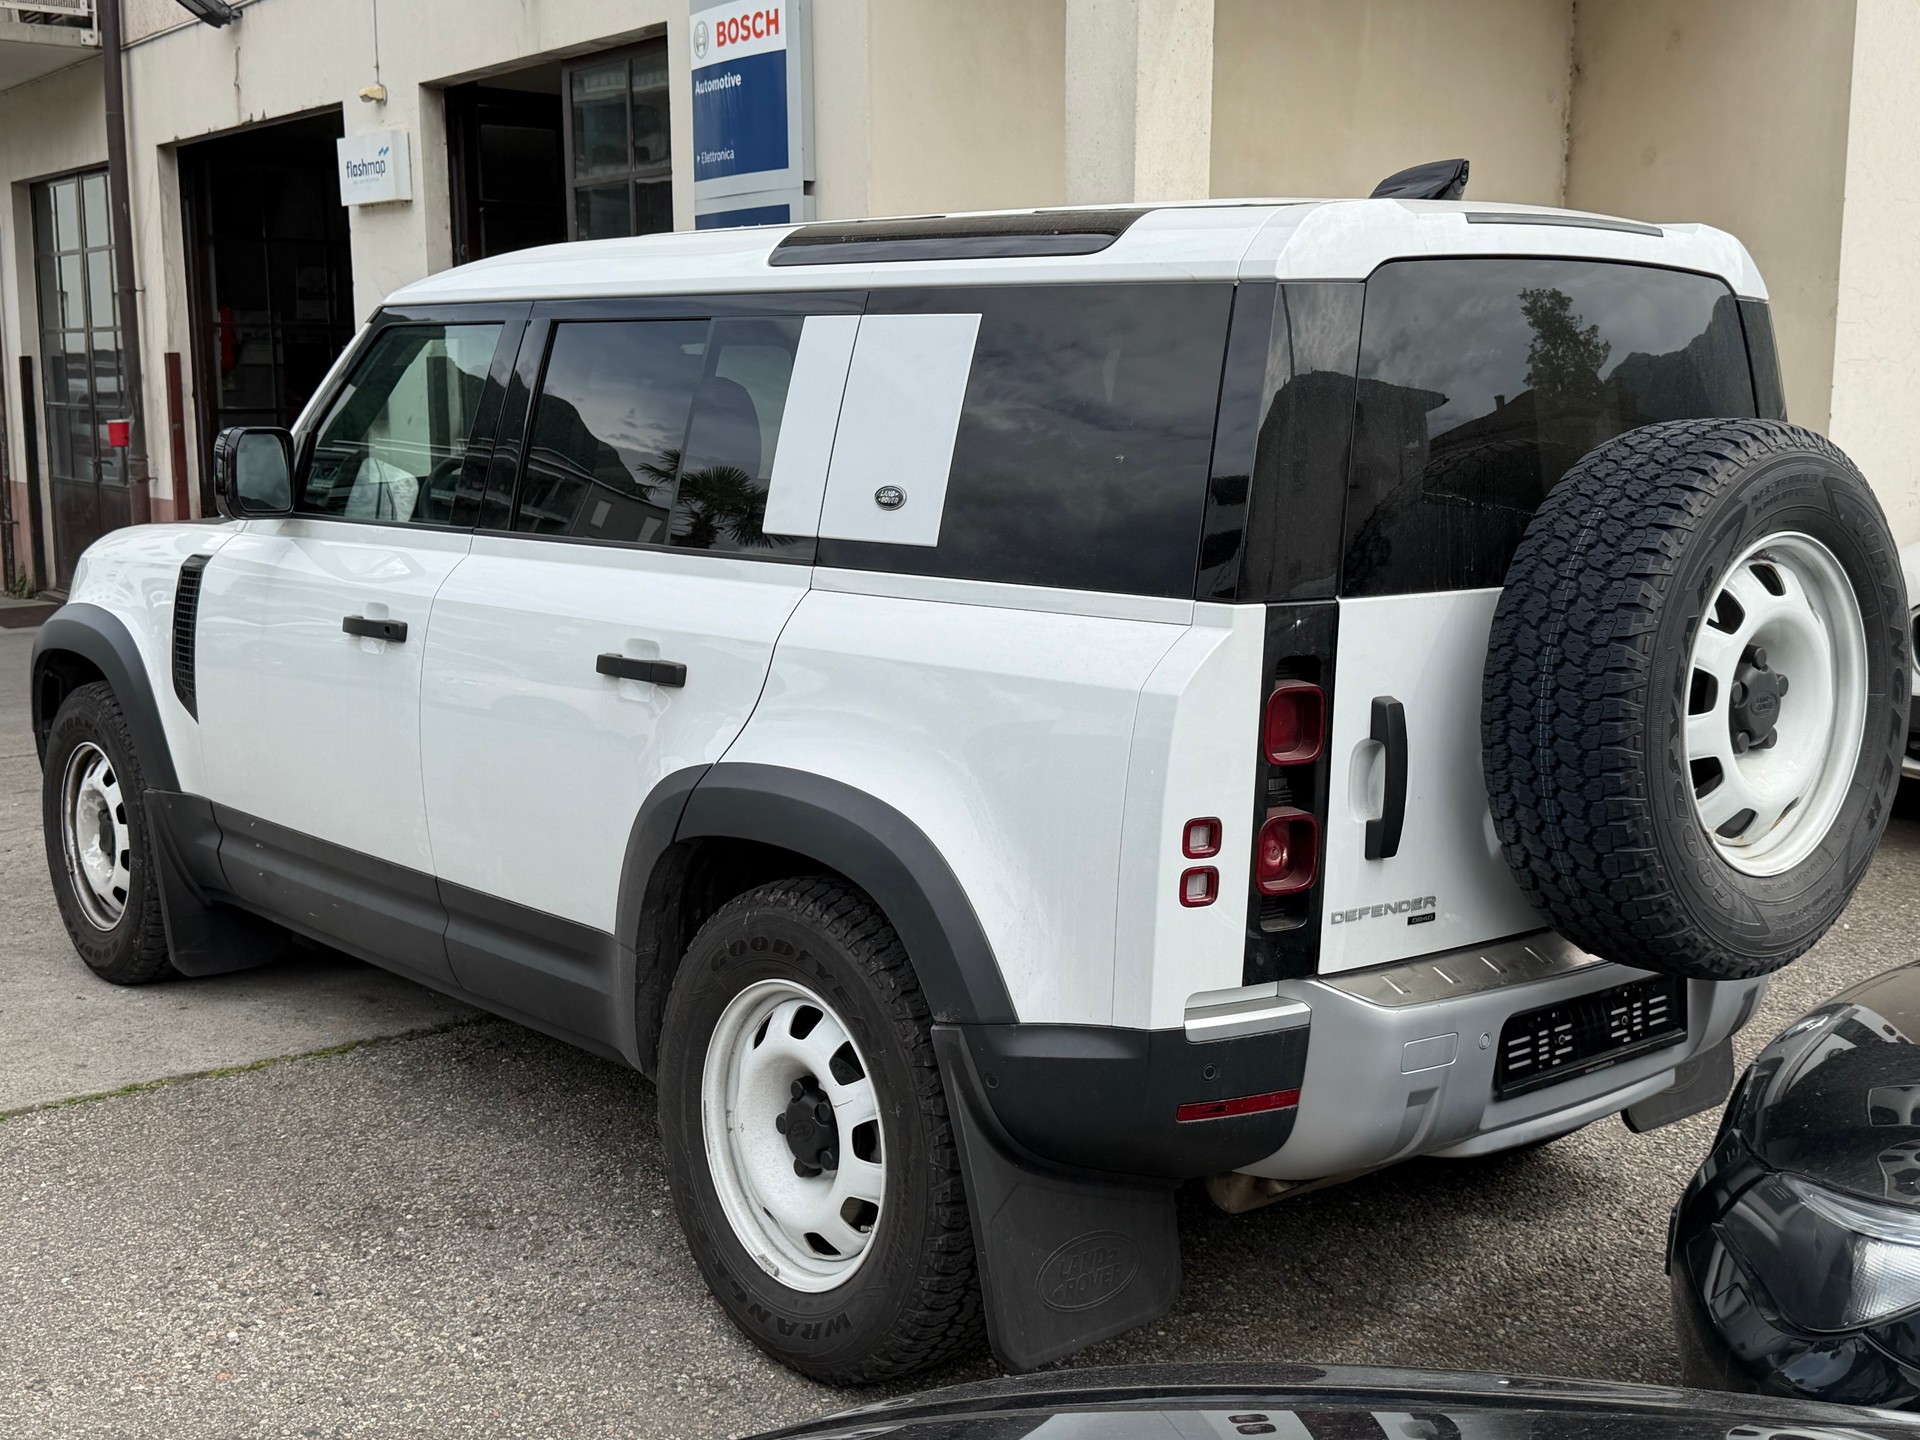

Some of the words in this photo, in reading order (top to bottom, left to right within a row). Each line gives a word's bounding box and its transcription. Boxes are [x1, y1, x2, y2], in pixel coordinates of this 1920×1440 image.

[716, 8, 780, 48] BOSCH
[695, 72, 742, 95] Automotive
[701, 148, 735, 164] Elettronica
[346, 158, 386, 178] flashmap
[1331, 896, 1437, 925] DEFENDER
